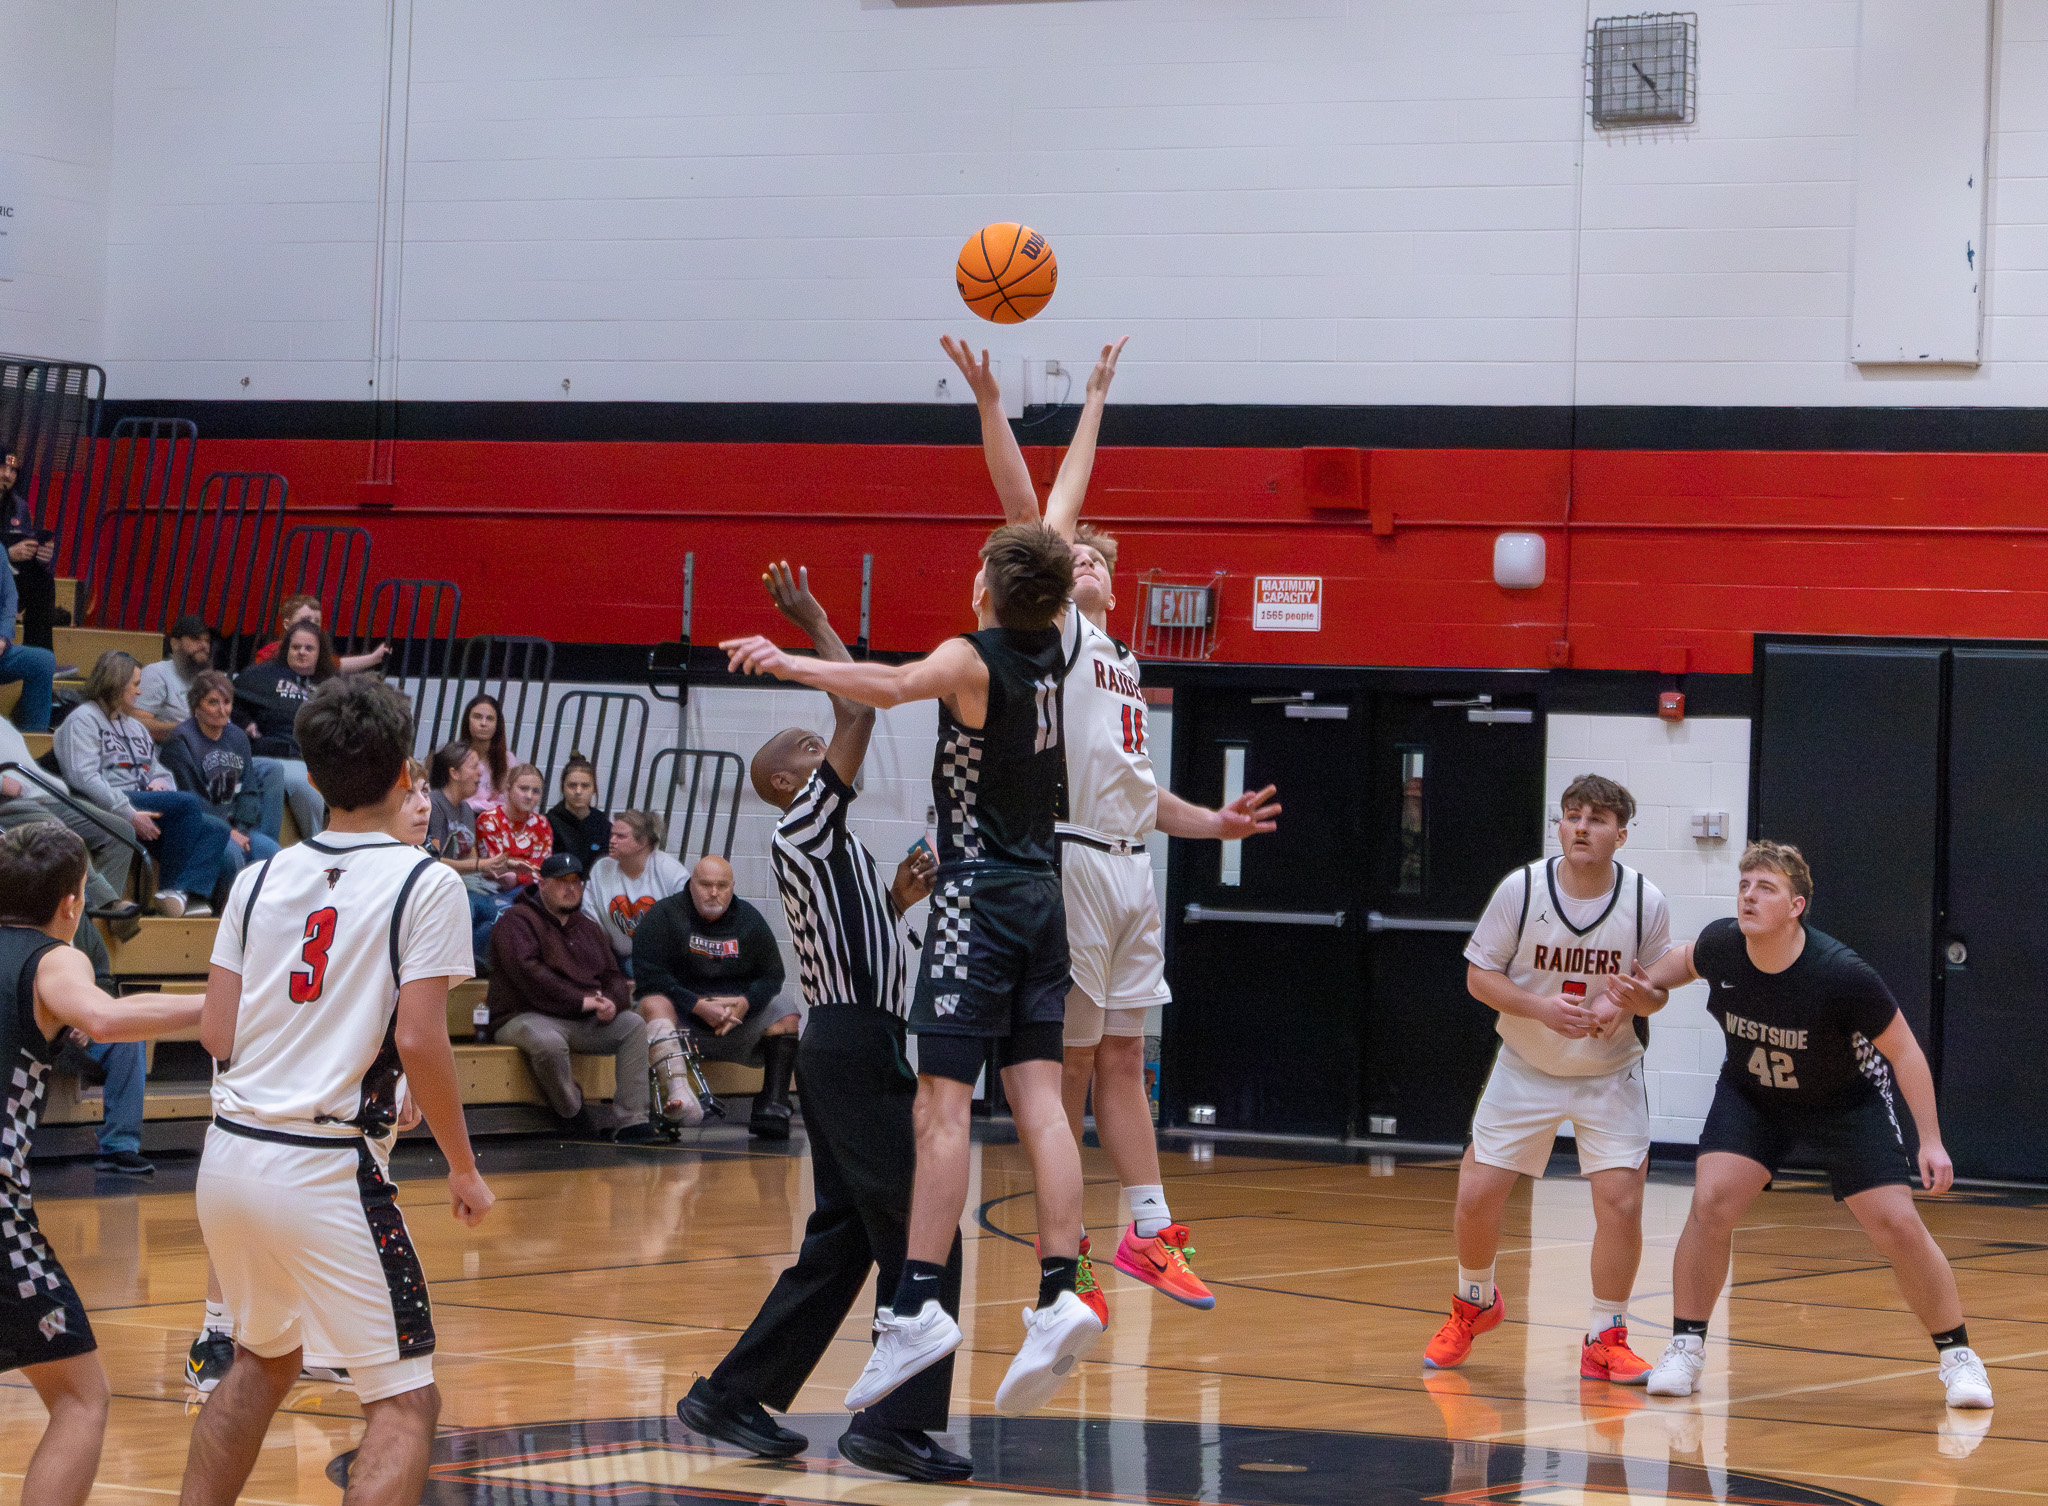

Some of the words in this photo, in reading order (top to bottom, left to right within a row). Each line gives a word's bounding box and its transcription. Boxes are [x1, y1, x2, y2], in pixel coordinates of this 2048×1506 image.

[1261, 580, 1316, 592] MAXIMUM
[1262, 591, 1313, 603] CAPACITY
[1160, 590, 1201, 624] EXIT
[1285, 611, 1314, 623] people
[1034, 673, 1058, 755] 11
[1121, 703, 1146, 756] 11
[288, 906, 338, 1005] 3
[1534, 944, 1622, 976] RAIDERS
[1725, 1011, 1808, 1050] WESTSIDE
[1747, 1046, 1799, 1089] 42
